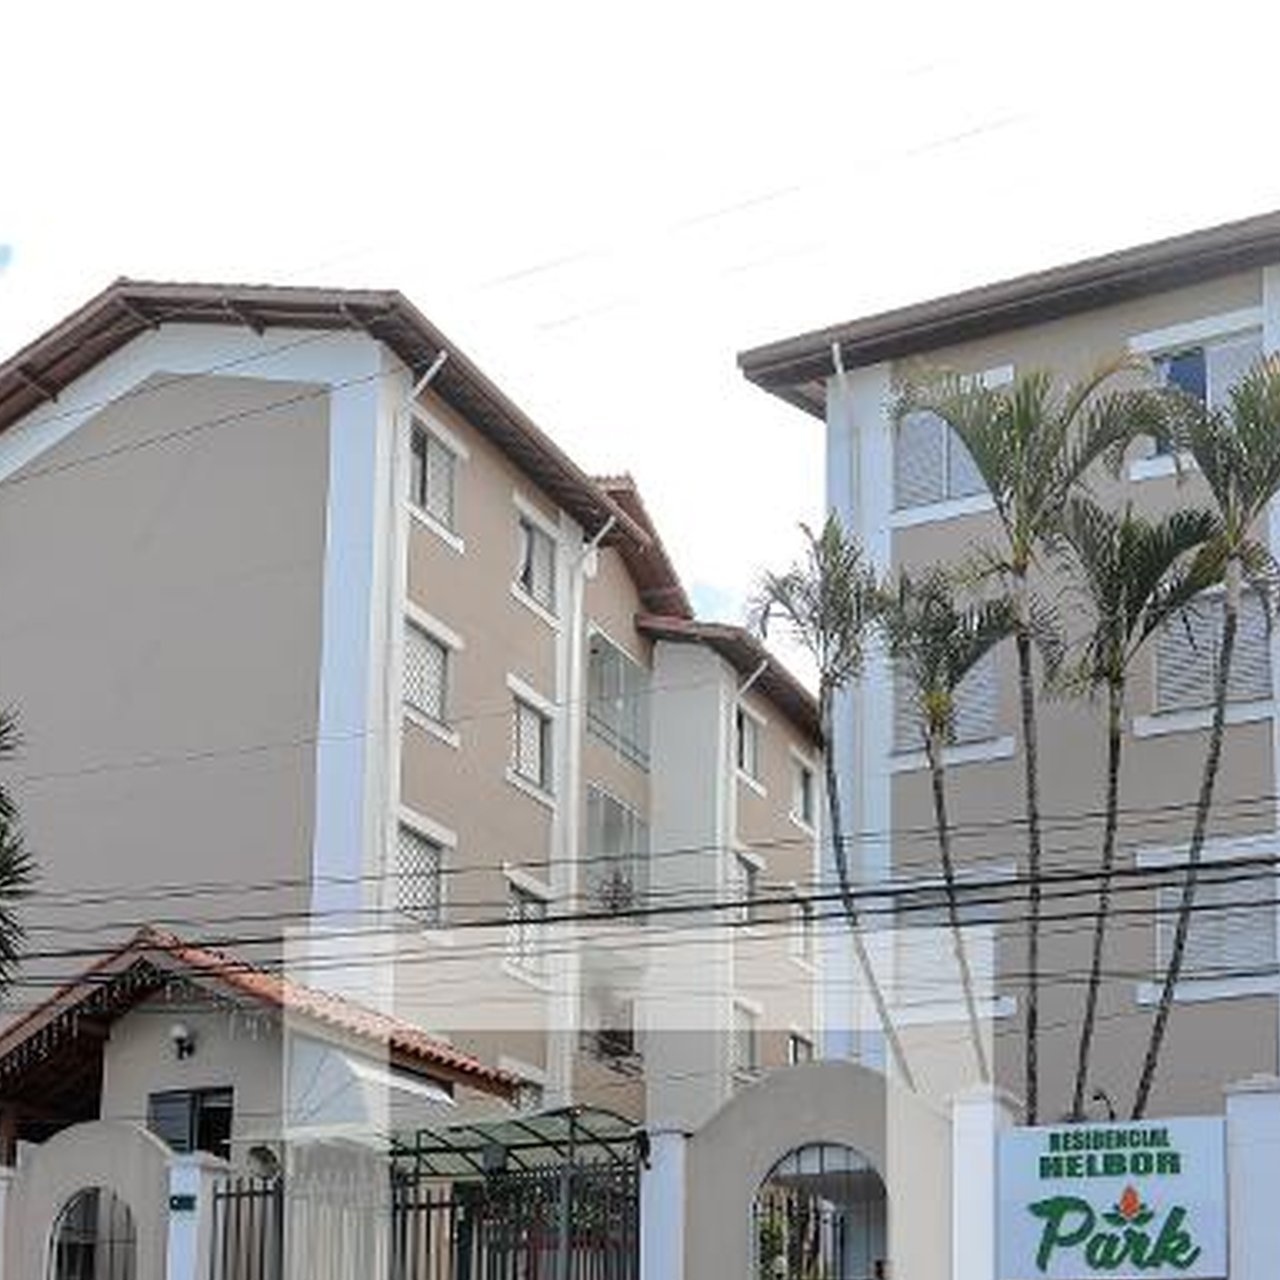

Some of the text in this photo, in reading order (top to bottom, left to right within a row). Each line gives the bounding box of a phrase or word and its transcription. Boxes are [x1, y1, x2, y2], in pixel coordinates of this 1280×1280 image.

[1049, 1127, 1170, 1153] RESIDENCIAL
[1039, 1152, 1181, 1179] HELBOR
[1027, 1196, 1201, 1273] Park
